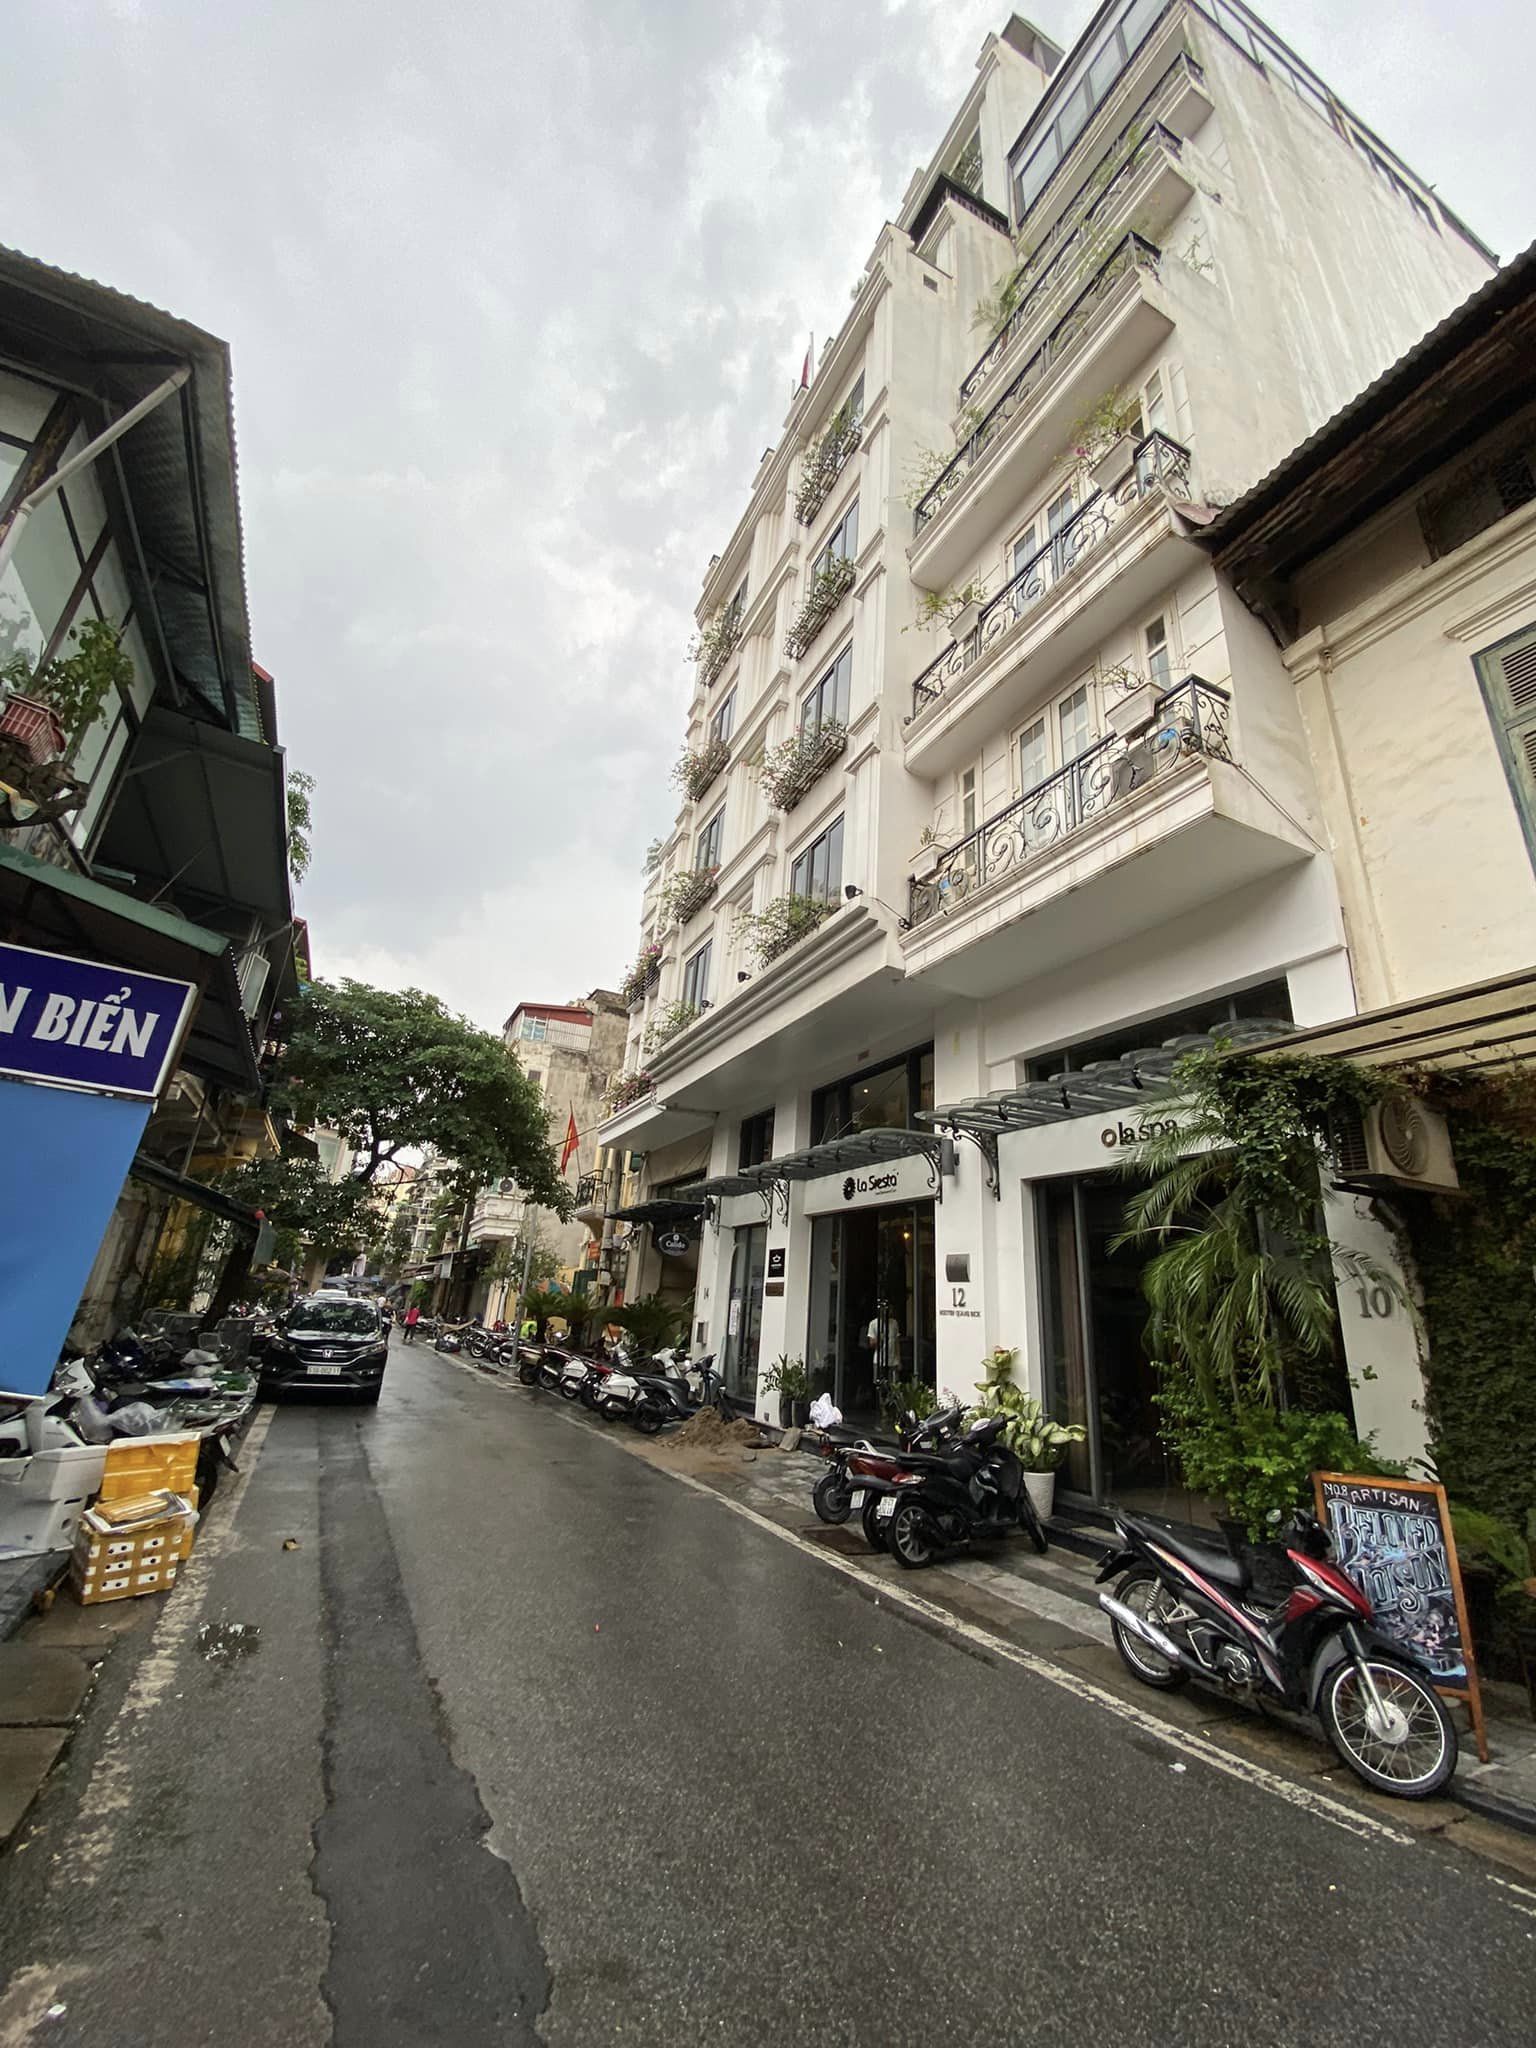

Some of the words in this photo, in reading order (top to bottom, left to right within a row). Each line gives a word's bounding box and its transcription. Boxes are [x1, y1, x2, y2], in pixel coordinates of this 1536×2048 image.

[32, 986, 161, 1058] BIỂN
[952, 1287, 967, 1308] 12
[1355, 1287, 1392, 1319] 10
[1350, 1488, 1420, 1512] ARTISAN
[1327, 1498, 1439, 1566] BELOVED
